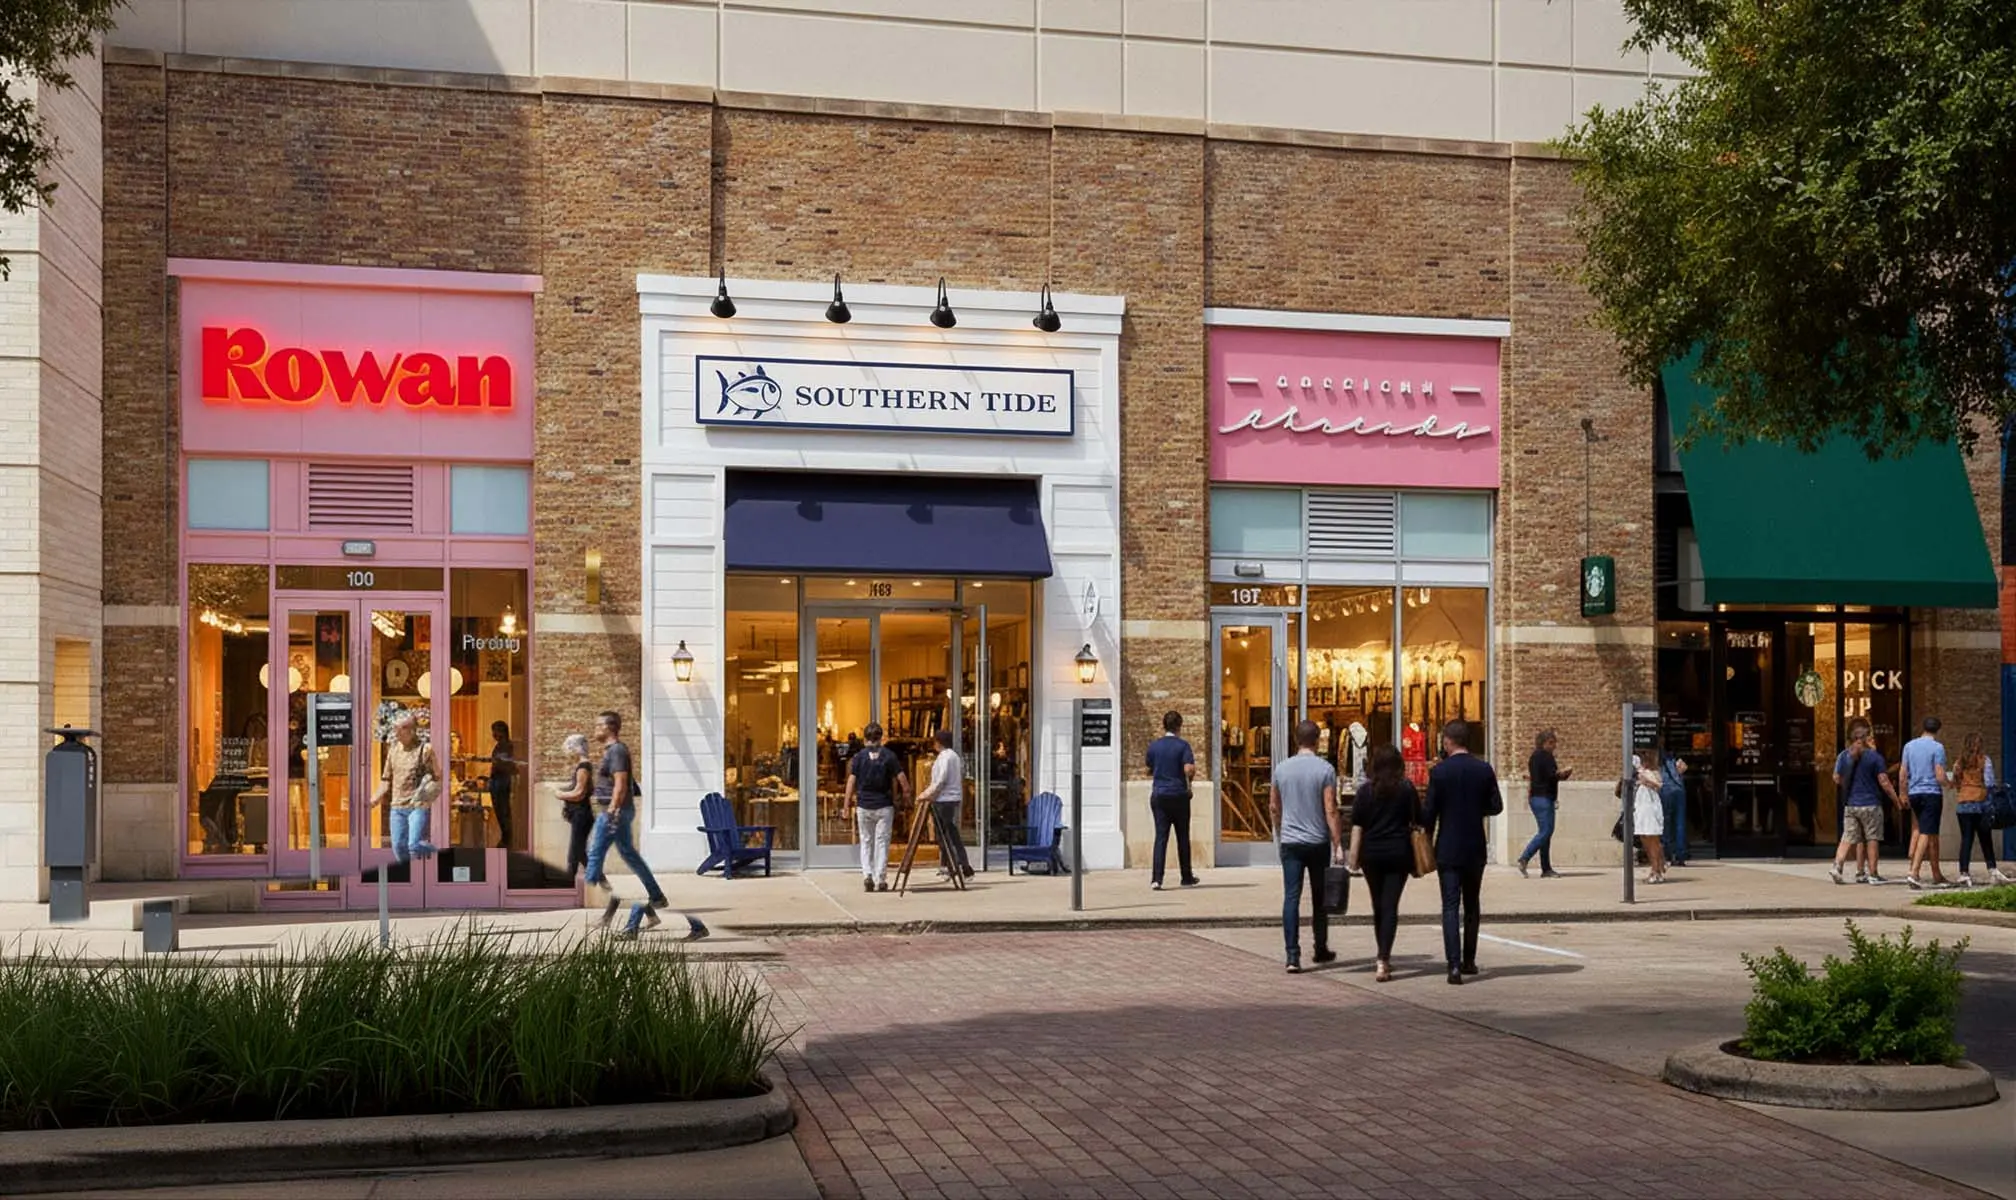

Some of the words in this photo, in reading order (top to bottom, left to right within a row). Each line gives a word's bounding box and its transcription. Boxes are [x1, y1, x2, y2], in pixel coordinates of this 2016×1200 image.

[202, 327, 512, 408] Rowan
[795, 386, 971, 411] SOUTHERN
[981, 392, 1056, 413] TIDE
[347, 571, 374, 587] 100
[1844, 670, 1903, 691] PICK
[1844, 697, 1872, 717] UP
